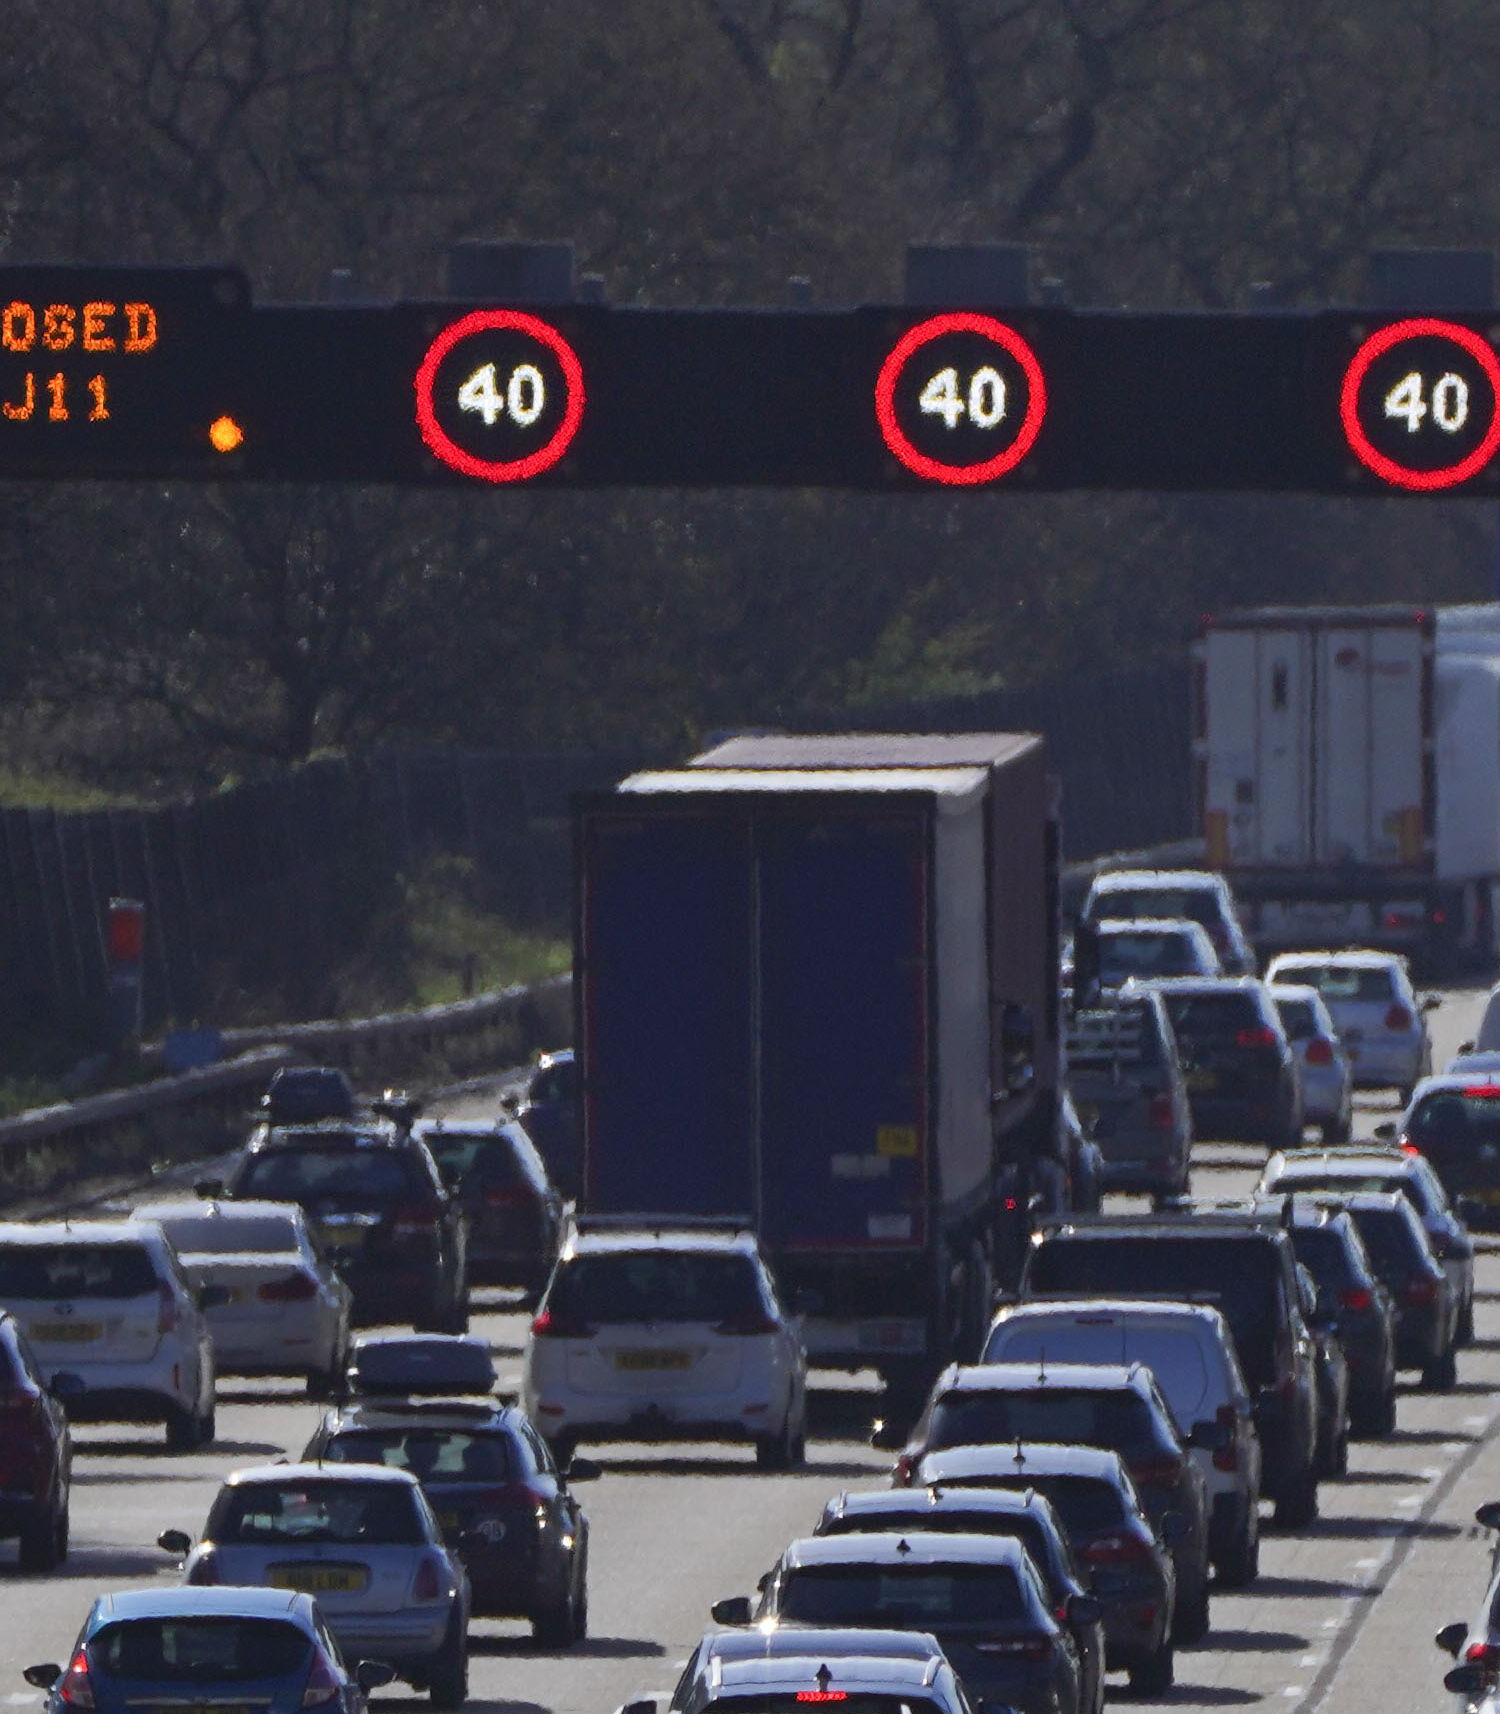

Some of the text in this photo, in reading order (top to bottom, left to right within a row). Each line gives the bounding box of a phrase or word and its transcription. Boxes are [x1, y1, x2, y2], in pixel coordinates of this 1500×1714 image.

[2, 372, 109, 421] J11
[458, 362, 545, 428] 40
[919, 366, 1007, 430] 40
[1384, 372, 1469, 433] 40
